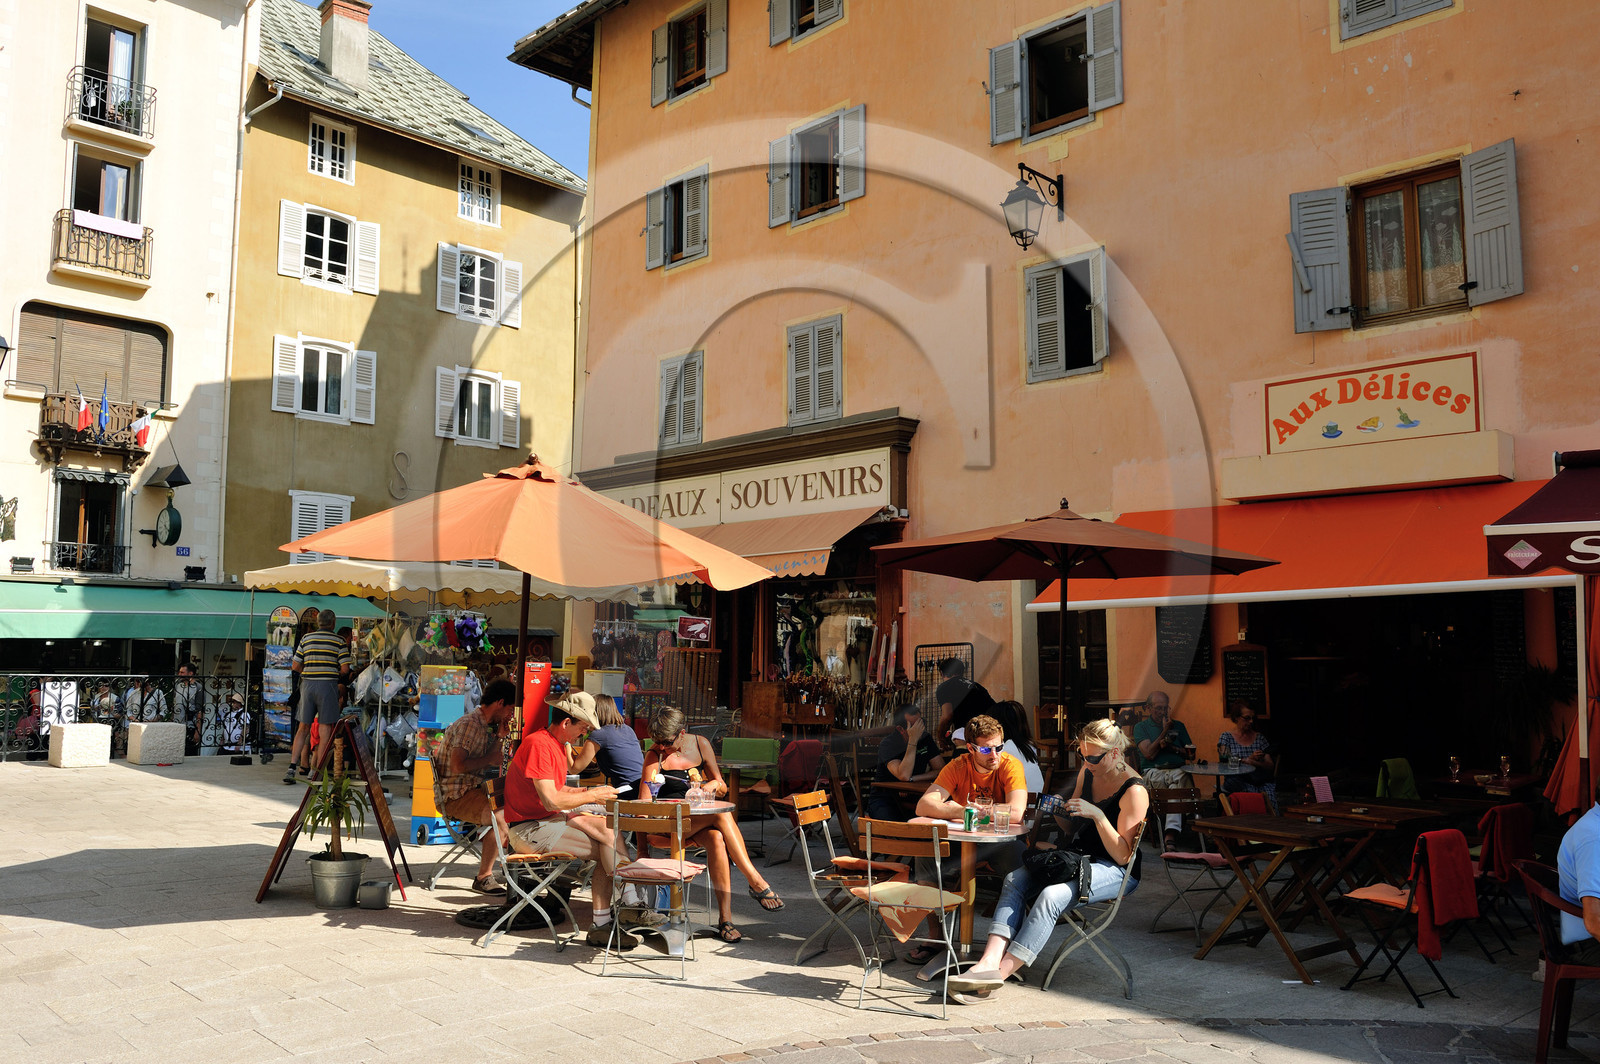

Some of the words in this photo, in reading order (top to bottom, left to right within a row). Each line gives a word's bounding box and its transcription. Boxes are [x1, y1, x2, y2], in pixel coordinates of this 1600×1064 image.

[1272, 388, 1333, 445] Aux
[1337, 372, 1472, 415] Délices
[731, 463, 884, 511] SOUVENIRS
